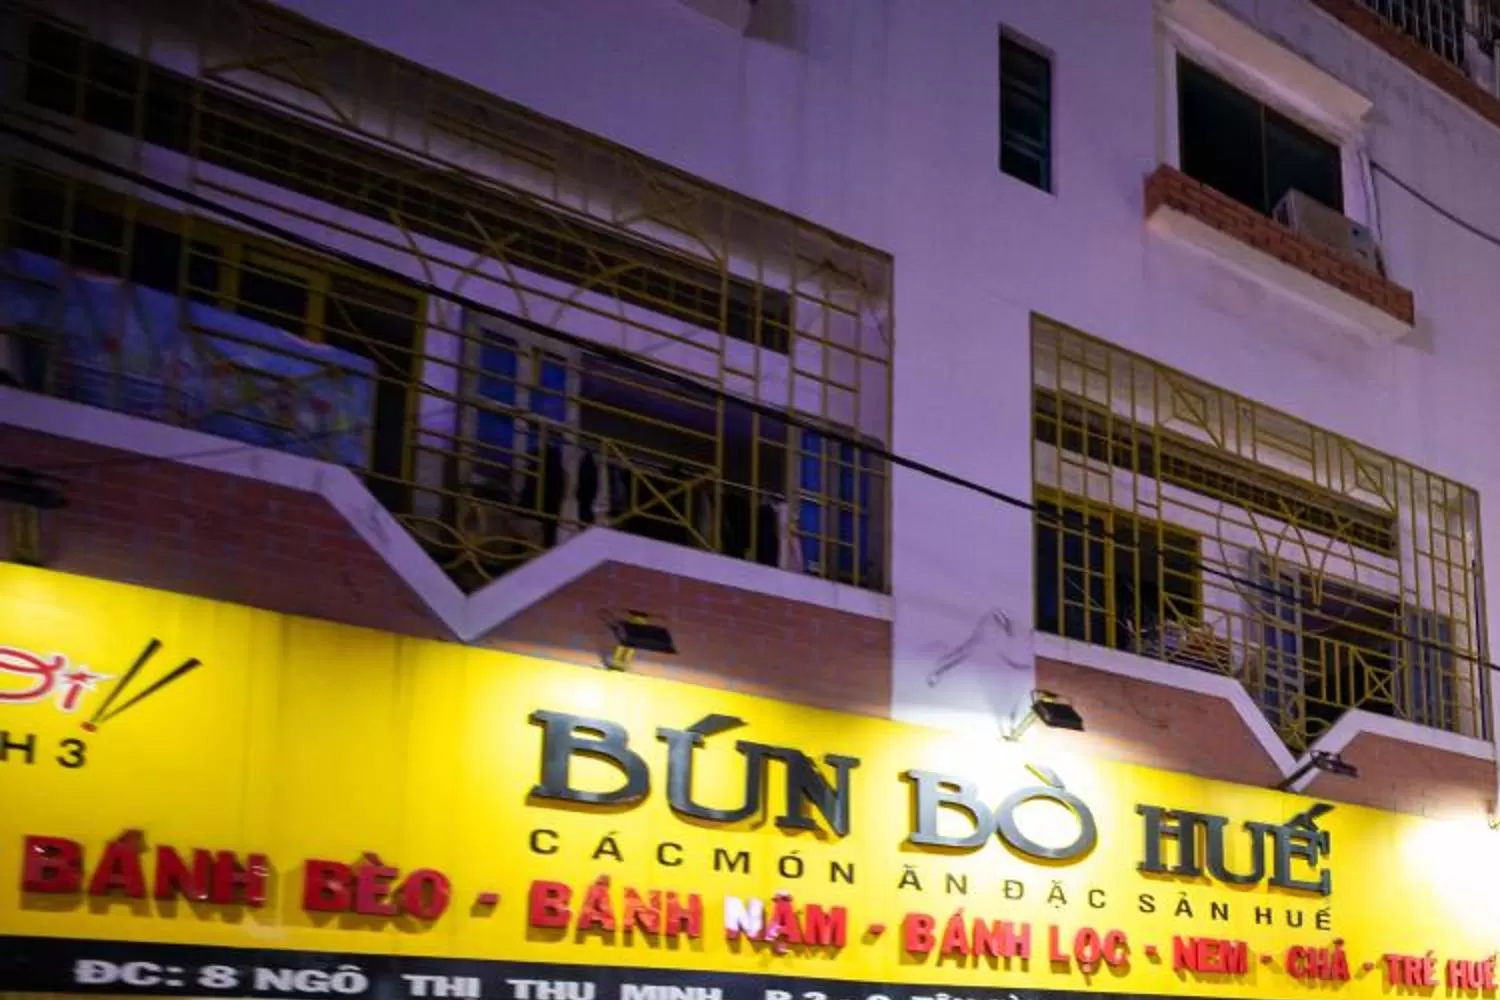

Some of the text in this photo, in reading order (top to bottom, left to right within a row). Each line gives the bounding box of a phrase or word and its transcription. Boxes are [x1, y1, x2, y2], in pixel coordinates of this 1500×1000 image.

[56, 738, 87, 768] 3
[526, 709, 1337, 897] BÚN BÒ HUẾ
[22, 829, 270, 908] BÁNH
[302, 850, 452, 921] BÈO
[529, 874, 702, 939] BÁNH
[723, 889, 847, 954] NẬM
[904, 907, 1032, 960] BÁNH
[1049, 924, 1131, 974] LỌC
[1172, 934, 1248, 974] NEM
[1284, 938, 1351, 982] CHẢ
[1384, 949, 1439, 987] TRÉ
[1446, 950, 1500, 992] HUẾ
[898, 864, 968, 894] ĂN
[1003, 878, 1107, 909] ĐẶC
[1138, 892, 1230, 921] SẢN
[1255, 906, 1332, 931] HUẾ
[74, 958, 186, 988] ĐC:
[198, 963, 239, 989] 8
[253, 963, 368, 996] NGÔ
